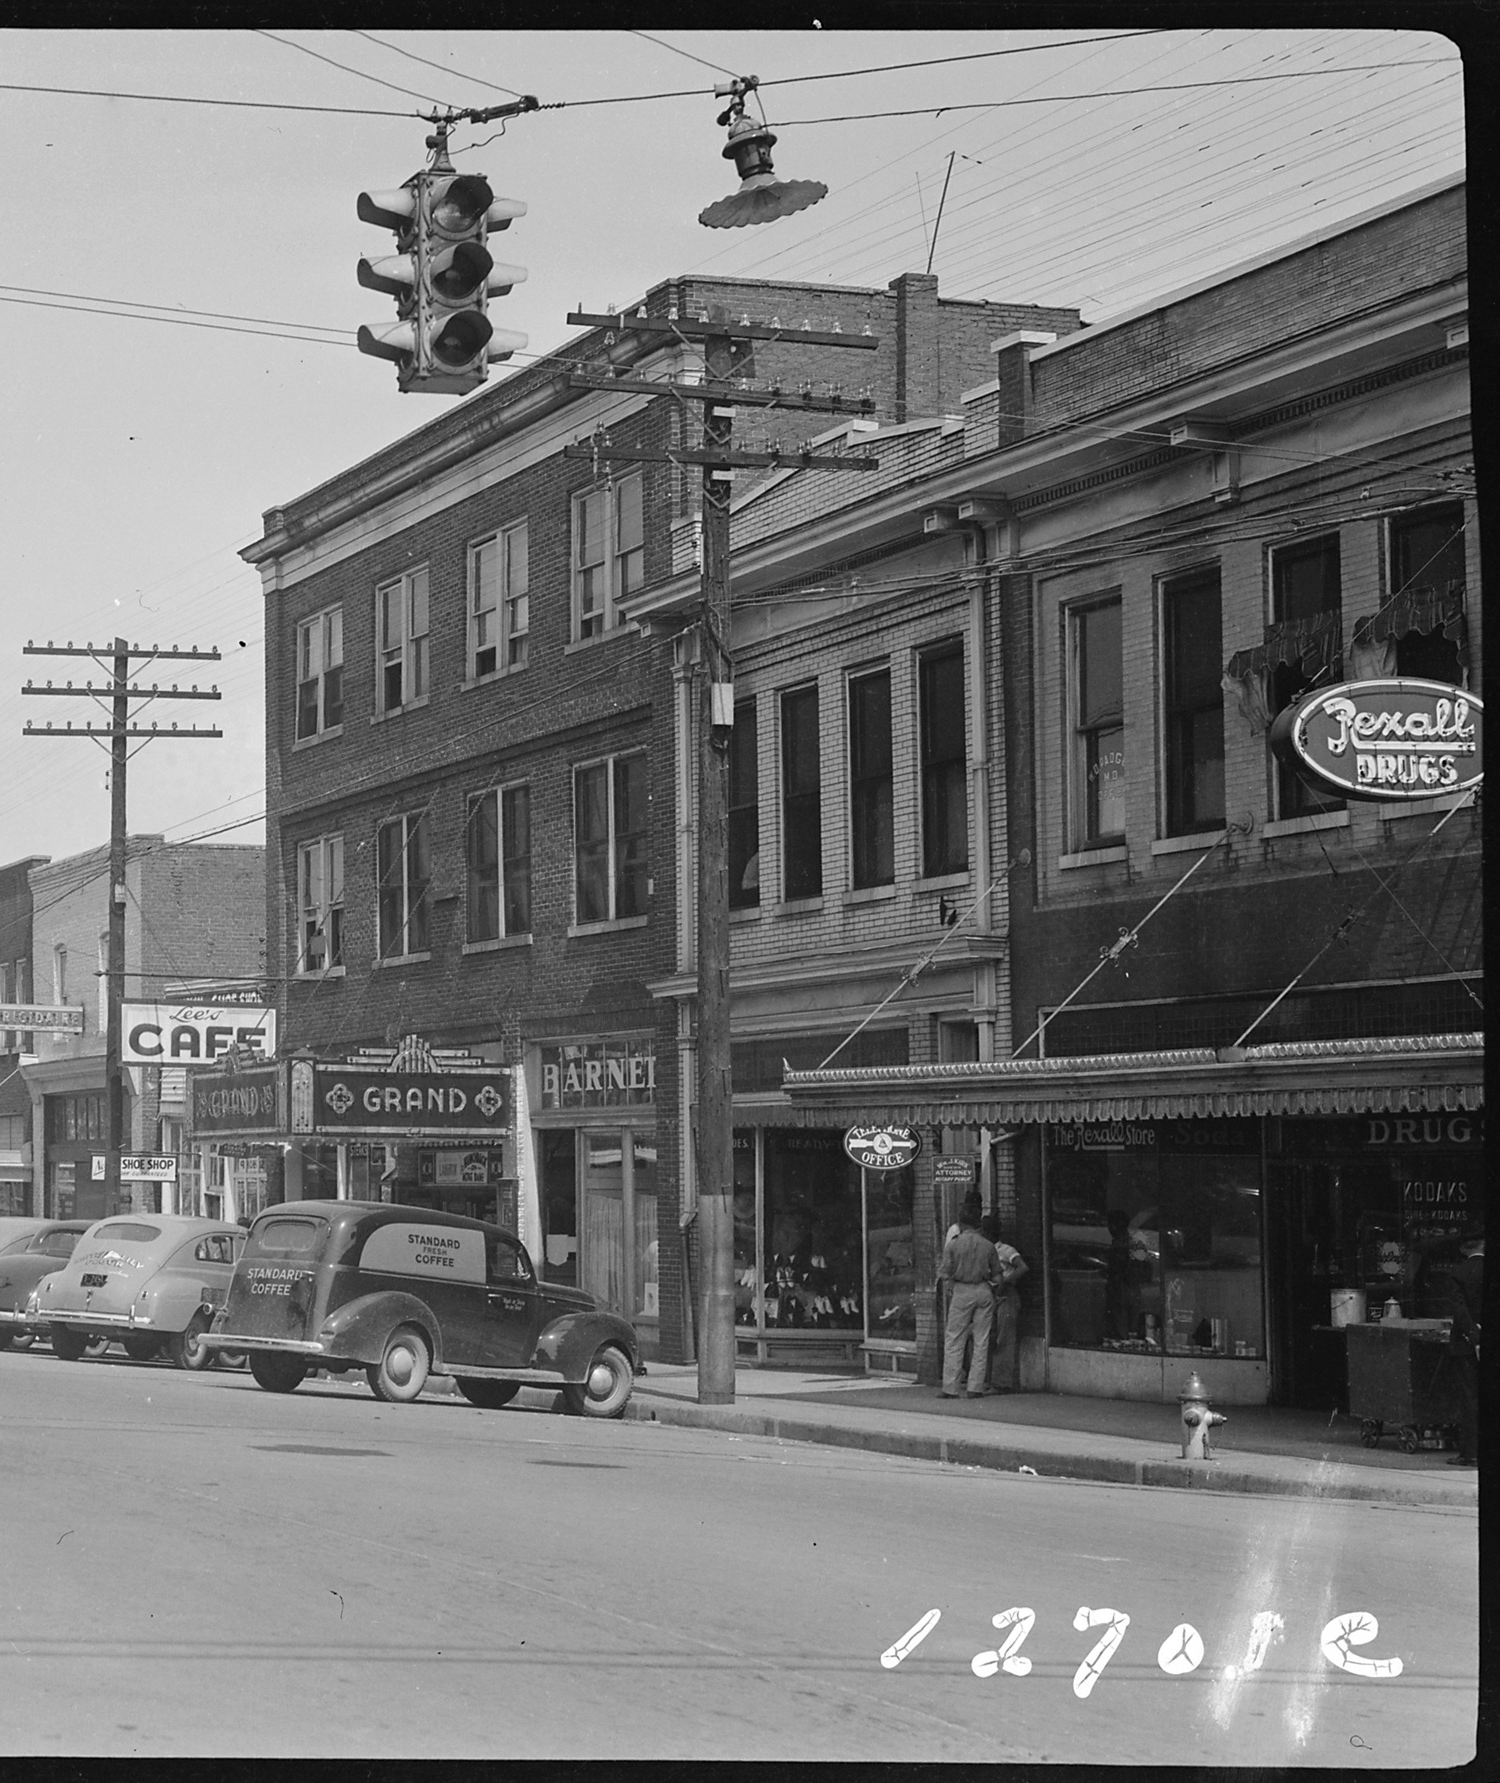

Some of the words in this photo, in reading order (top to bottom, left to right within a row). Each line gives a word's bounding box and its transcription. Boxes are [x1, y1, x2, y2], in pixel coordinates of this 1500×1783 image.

[1322, 695, 1477, 756] Rexall
[1355, 753, 1460, 786] DRUGS
[169, 1005, 224, 1023] Lee's
[129, 1023, 266, 1059] CAFE
[363, 1087, 467, 1113] GRAND
[1053, 1125, 1074, 1145] The
[1073, 1122, 1125, 1151] Rexall
[1126, 1123, 1155, 1146] Store
[1368, 1117, 1485, 1144] DRUG
[122, 1159, 146, 1170] SHOE
[147, 1159, 174, 1170] SHOP
[861, 1151, 904, 1166] OFFICE
[1403, 1182, 1467, 1202] KODAKS
[407, 1233, 461, 1250] STANDARD
[422, 1246, 448, 1256] FRESH
[415, 1253, 455, 1268] COFFEE
[247, 1267, 304, 1281] STANDARD
[251, 1283, 292, 1297] COFFEE
